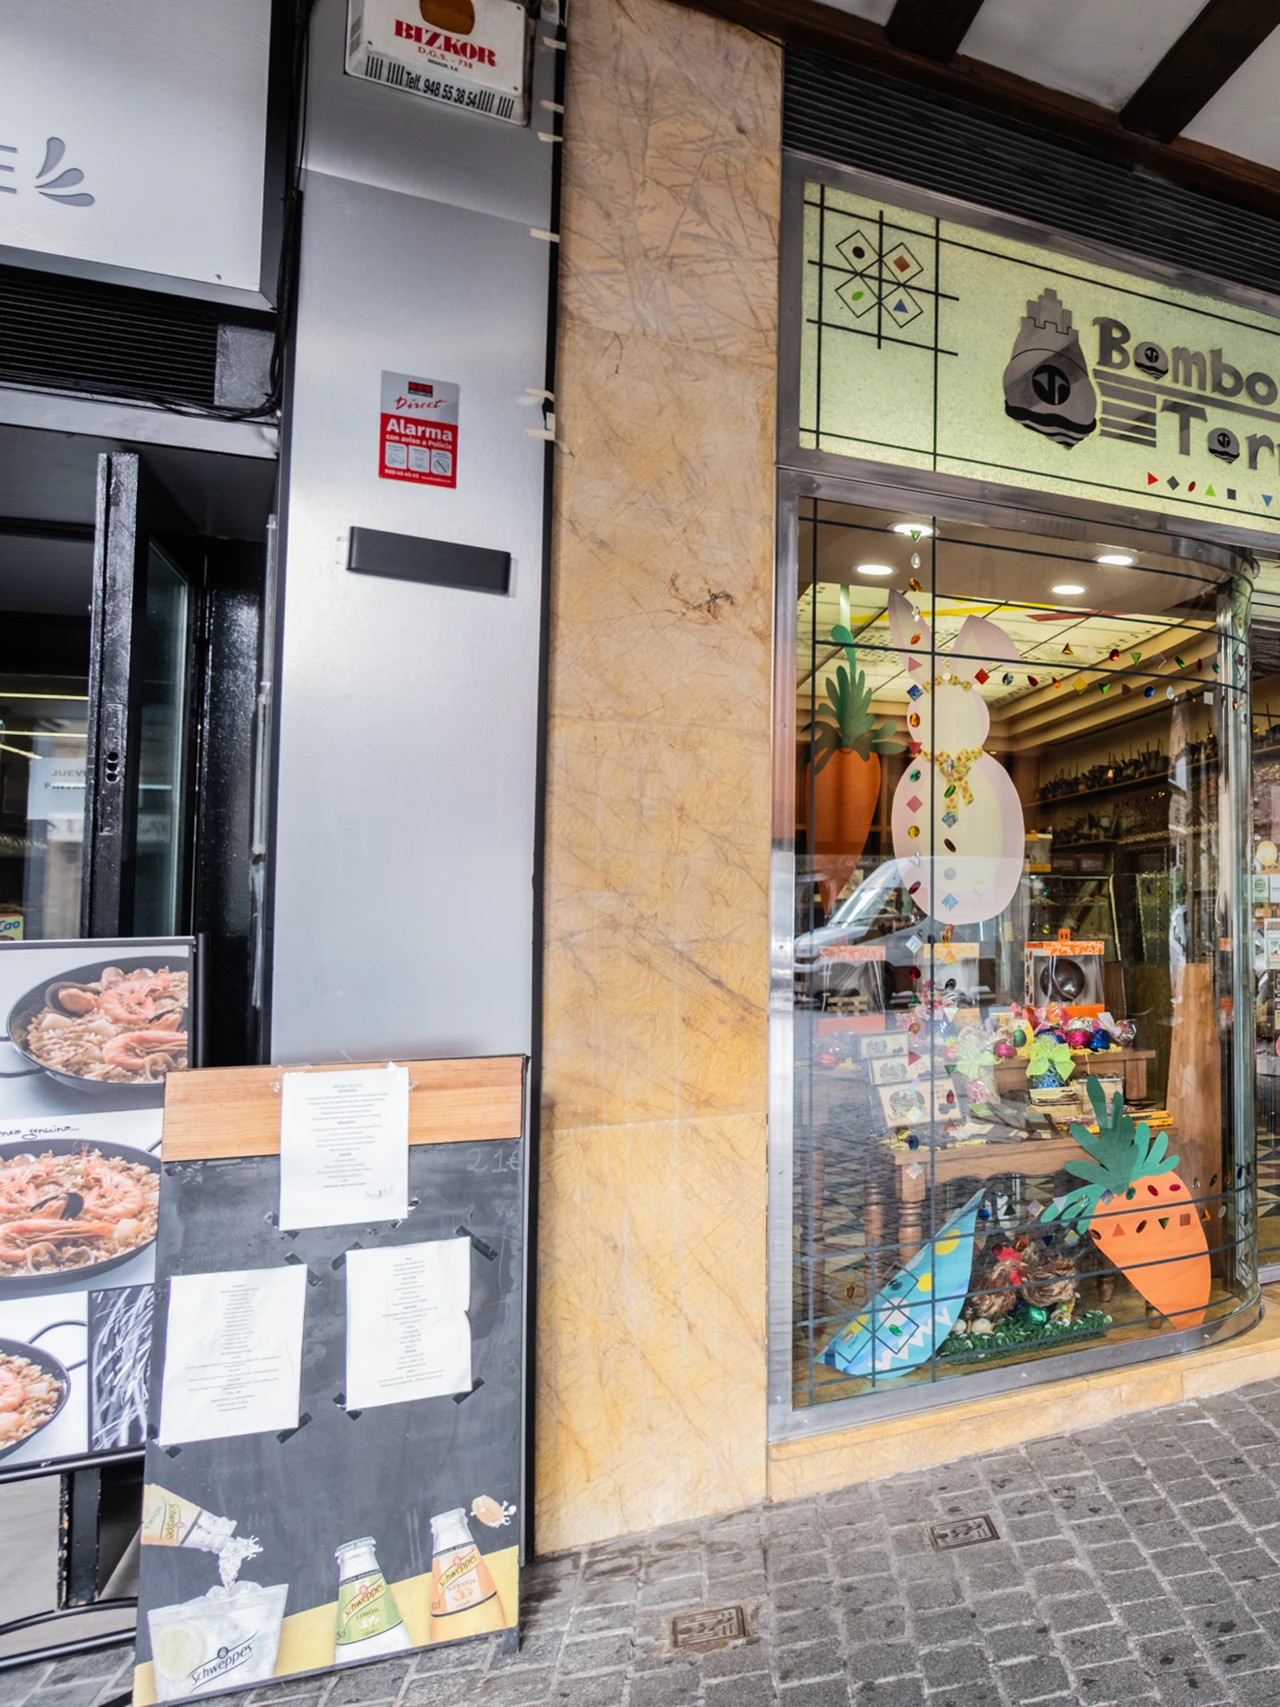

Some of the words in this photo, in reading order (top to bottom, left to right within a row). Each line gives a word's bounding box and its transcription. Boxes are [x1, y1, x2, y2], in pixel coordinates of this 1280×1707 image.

[393, 19, 497, 67] BIZKOR
[418, 46, 448, 62] D.G.S.
[458, 59, 473, 70] 738
[405, 71, 421, 92] Telf.
[422, 78, 441, 98] 948
[442, 84, 454, 101] 55
[454, 89, 466, 105] 38
[466, 92, 478, 108] 54
[386, 418, 453, 442] Alarma
[401, 436, 420, 445] aviso
[51, 769, 88, 778] JUEV
[439, 1554, 477, 1588] Schweppes
[344, 1582, 385, 1618] Schweppes
[190, 1642, 253, 1685] Schweppes
